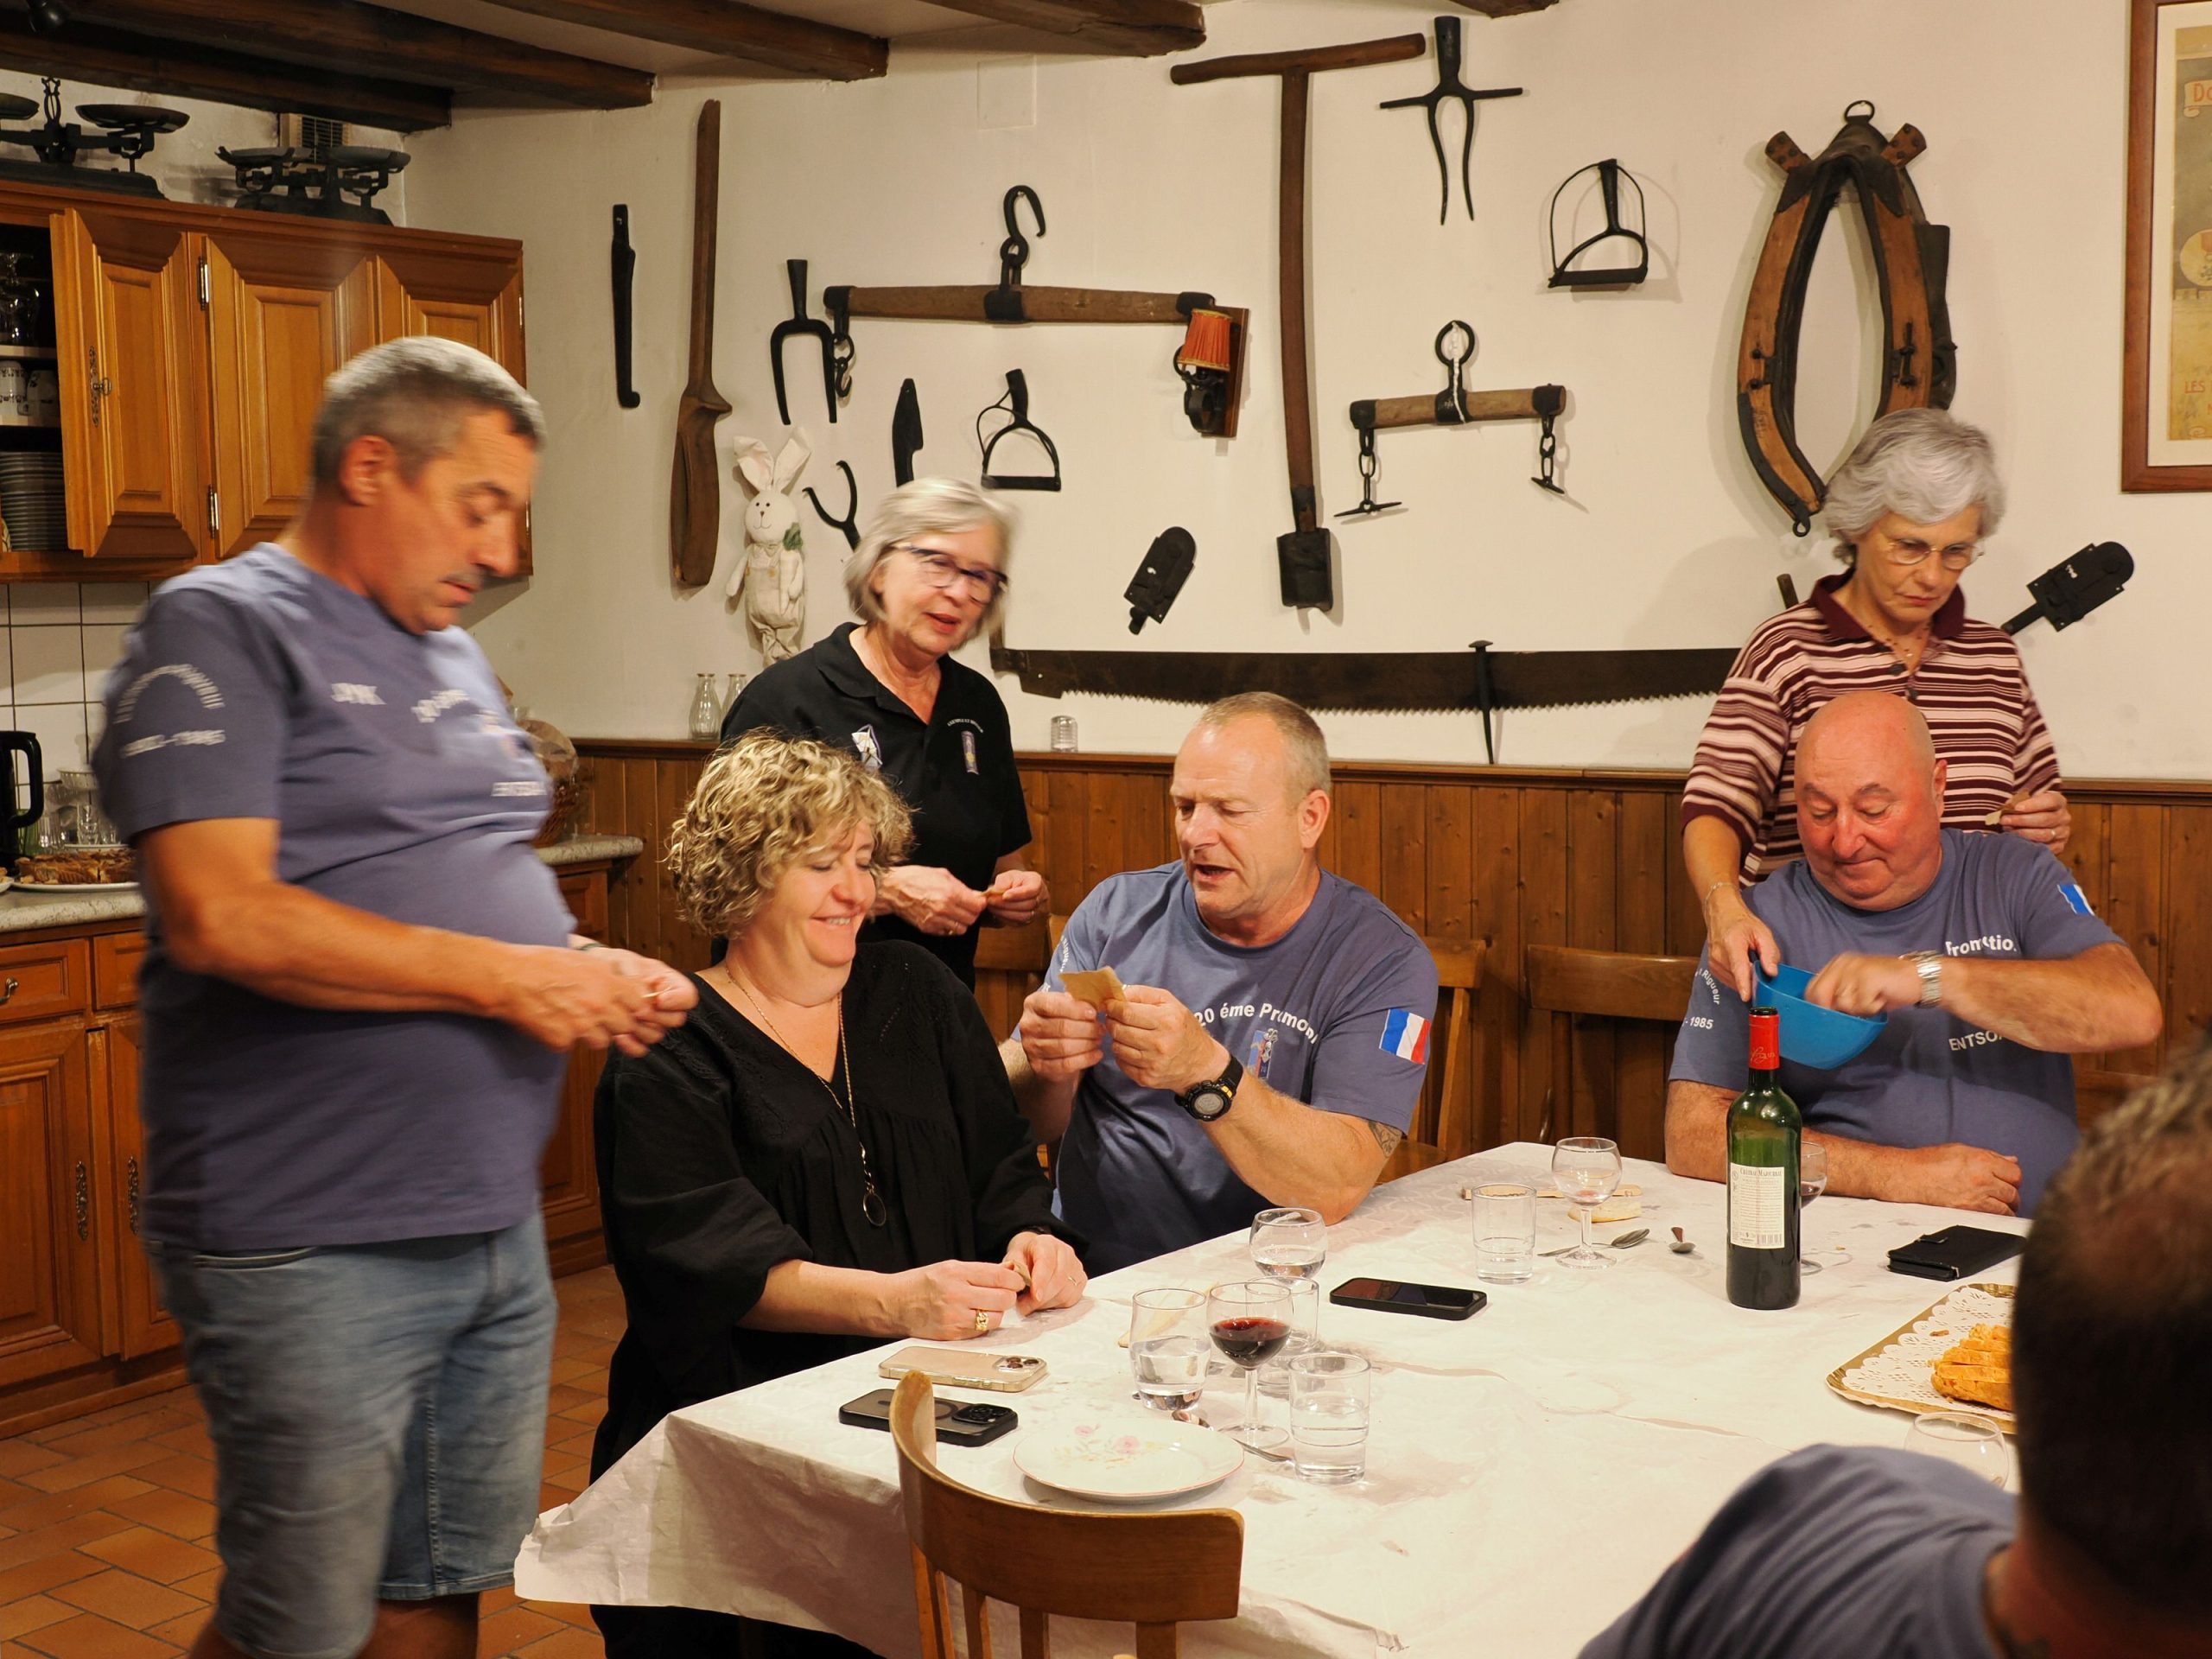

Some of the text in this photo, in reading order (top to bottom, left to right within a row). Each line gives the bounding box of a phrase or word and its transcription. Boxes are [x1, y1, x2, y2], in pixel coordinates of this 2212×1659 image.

[1219, 1002, 1255, 1019] éme
[1689, 1016, 1714, 1029] 1985
[1948, 1030, 2003, 1051] ENTSO
